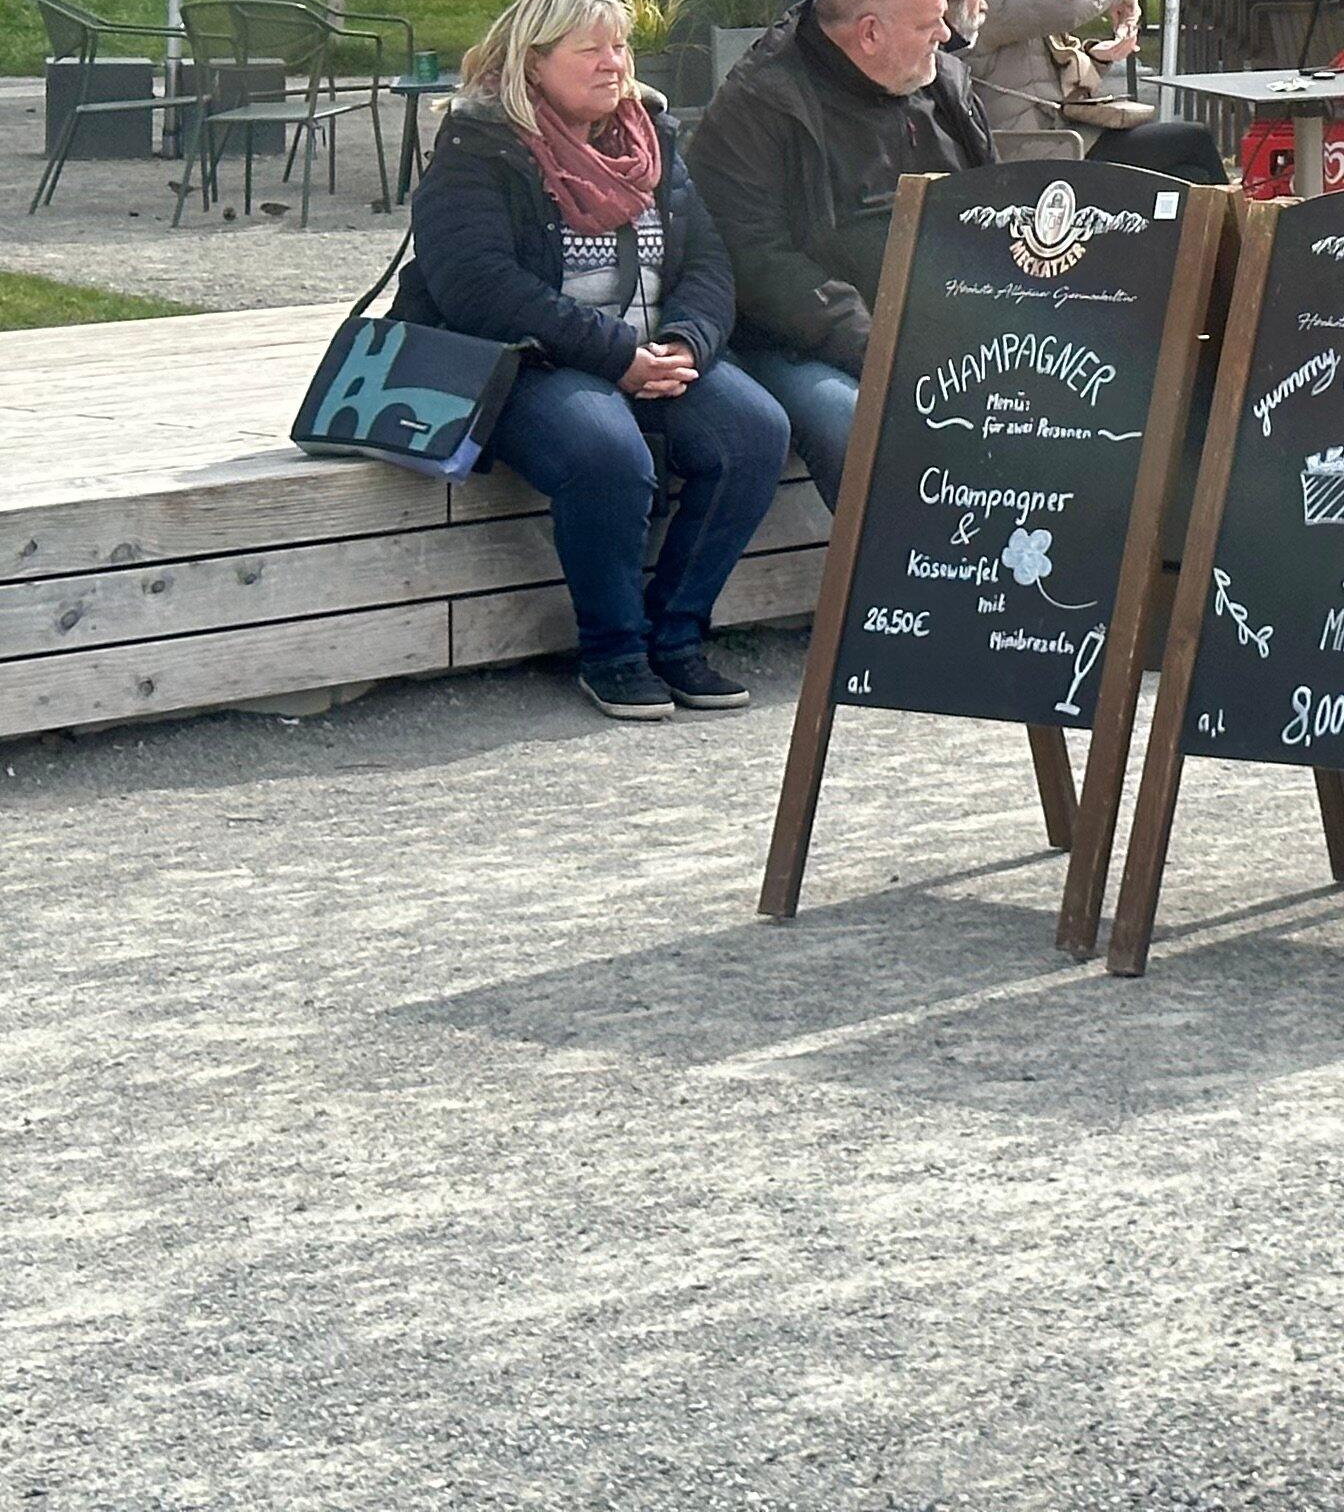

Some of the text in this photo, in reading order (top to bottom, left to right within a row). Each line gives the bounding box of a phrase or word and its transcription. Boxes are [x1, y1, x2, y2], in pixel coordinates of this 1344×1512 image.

[1009, 240, 1086, 278] MECKATZER
[915, 333, 1117, 415] CHAMPAGNER
[1253, 348, 1341, 437] yummy
[1036, 417, 1092, 439] Personen
[919, 467, 1075, 526] Champagner
[950, 512, 980, 545] &
[977, 593, 1006, 613] mit
[990, 628, 1075, 655] Minibrezeln
